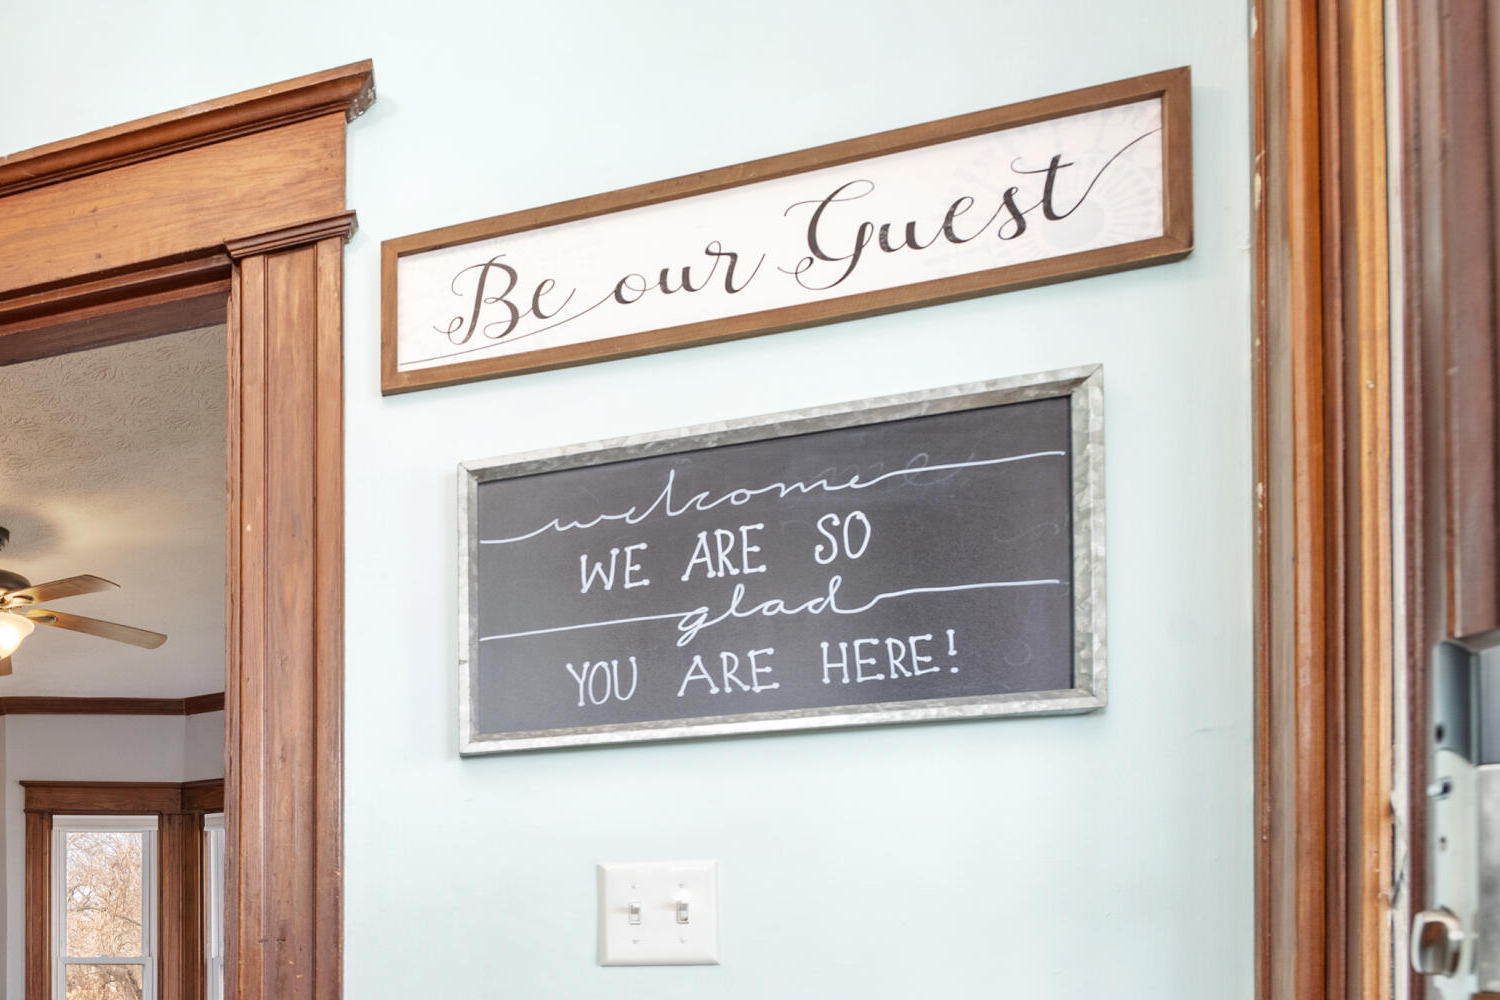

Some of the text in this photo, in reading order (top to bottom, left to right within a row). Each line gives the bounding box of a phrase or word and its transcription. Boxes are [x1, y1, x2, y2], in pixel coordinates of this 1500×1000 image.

[433, 128, 1161, 346] Be our Guest
[548, 468, 888, 532] welcome
[579, 510, 871, 594] WE ARE SO
[676, 575, 878, 647] glad
[565, 629, 959, 707] YOU ARE HERE!
